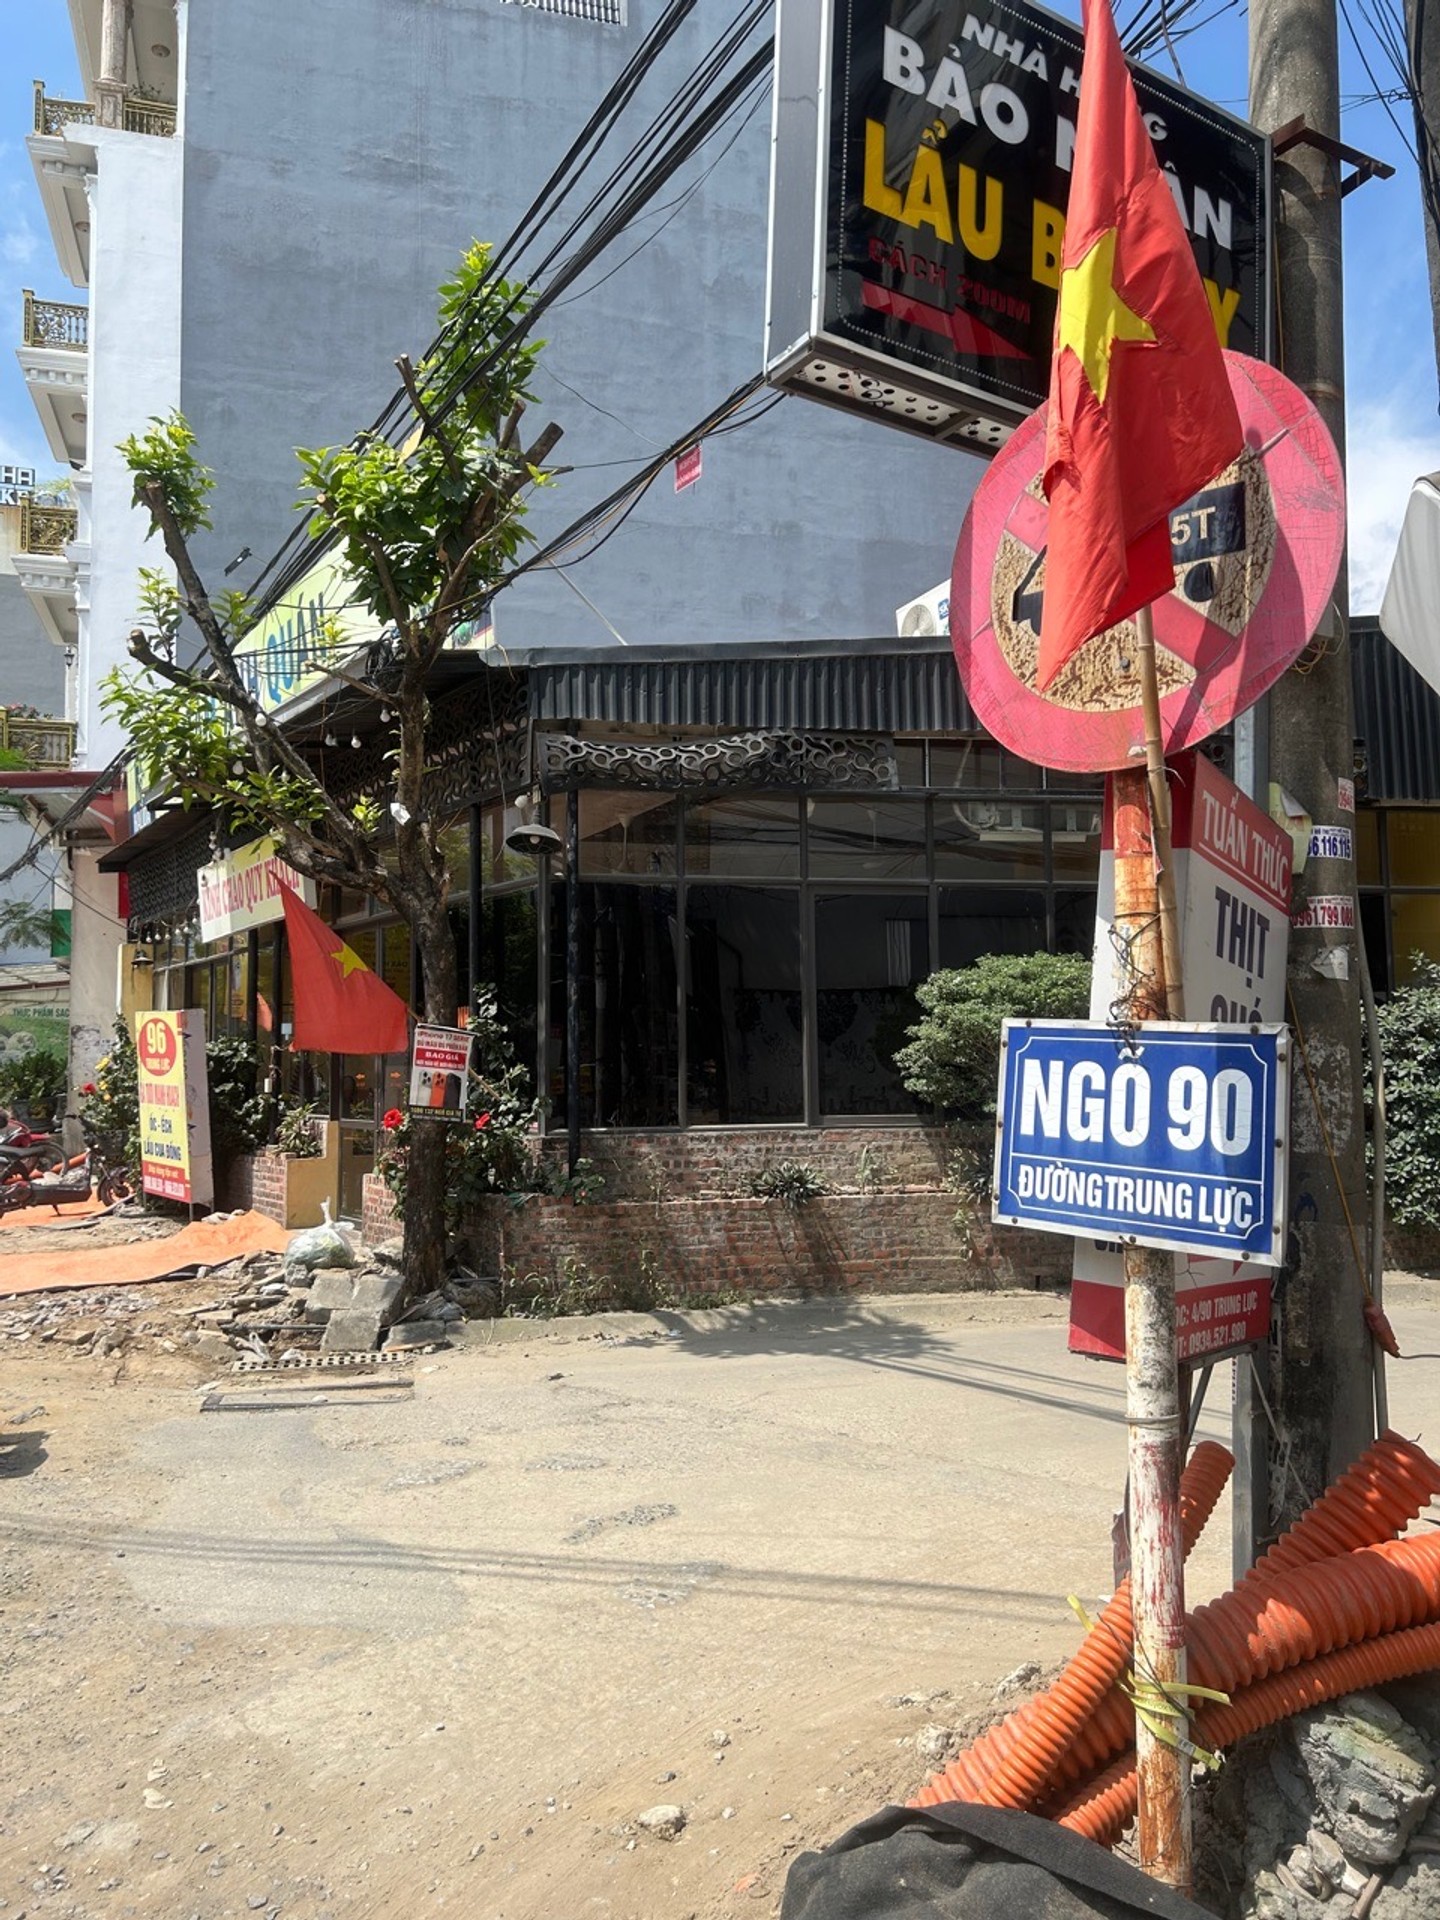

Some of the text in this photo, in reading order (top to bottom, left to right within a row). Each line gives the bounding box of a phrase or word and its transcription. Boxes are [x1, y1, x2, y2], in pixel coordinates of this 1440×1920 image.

[883, 24, 1030, 145] BẢO
[961, 13, 1049, 82] NHÀ
[863, 119, 1003, 261] LẨU
[869, 236, 946, 289] CÁCH
[1203, 791, 1289, 899] TUẤN THỨC
[1215, 886, 1271, 989] THỊT
[147, 1021, 167, 1054] 96
[1019, 1046, 1254, 1156] NGÕ 90
[1018, 1163, 1254, 1233] ĐƯỜNG TRUNG LỰC
[1214, 1294, 1242, 1318] TRUNG
